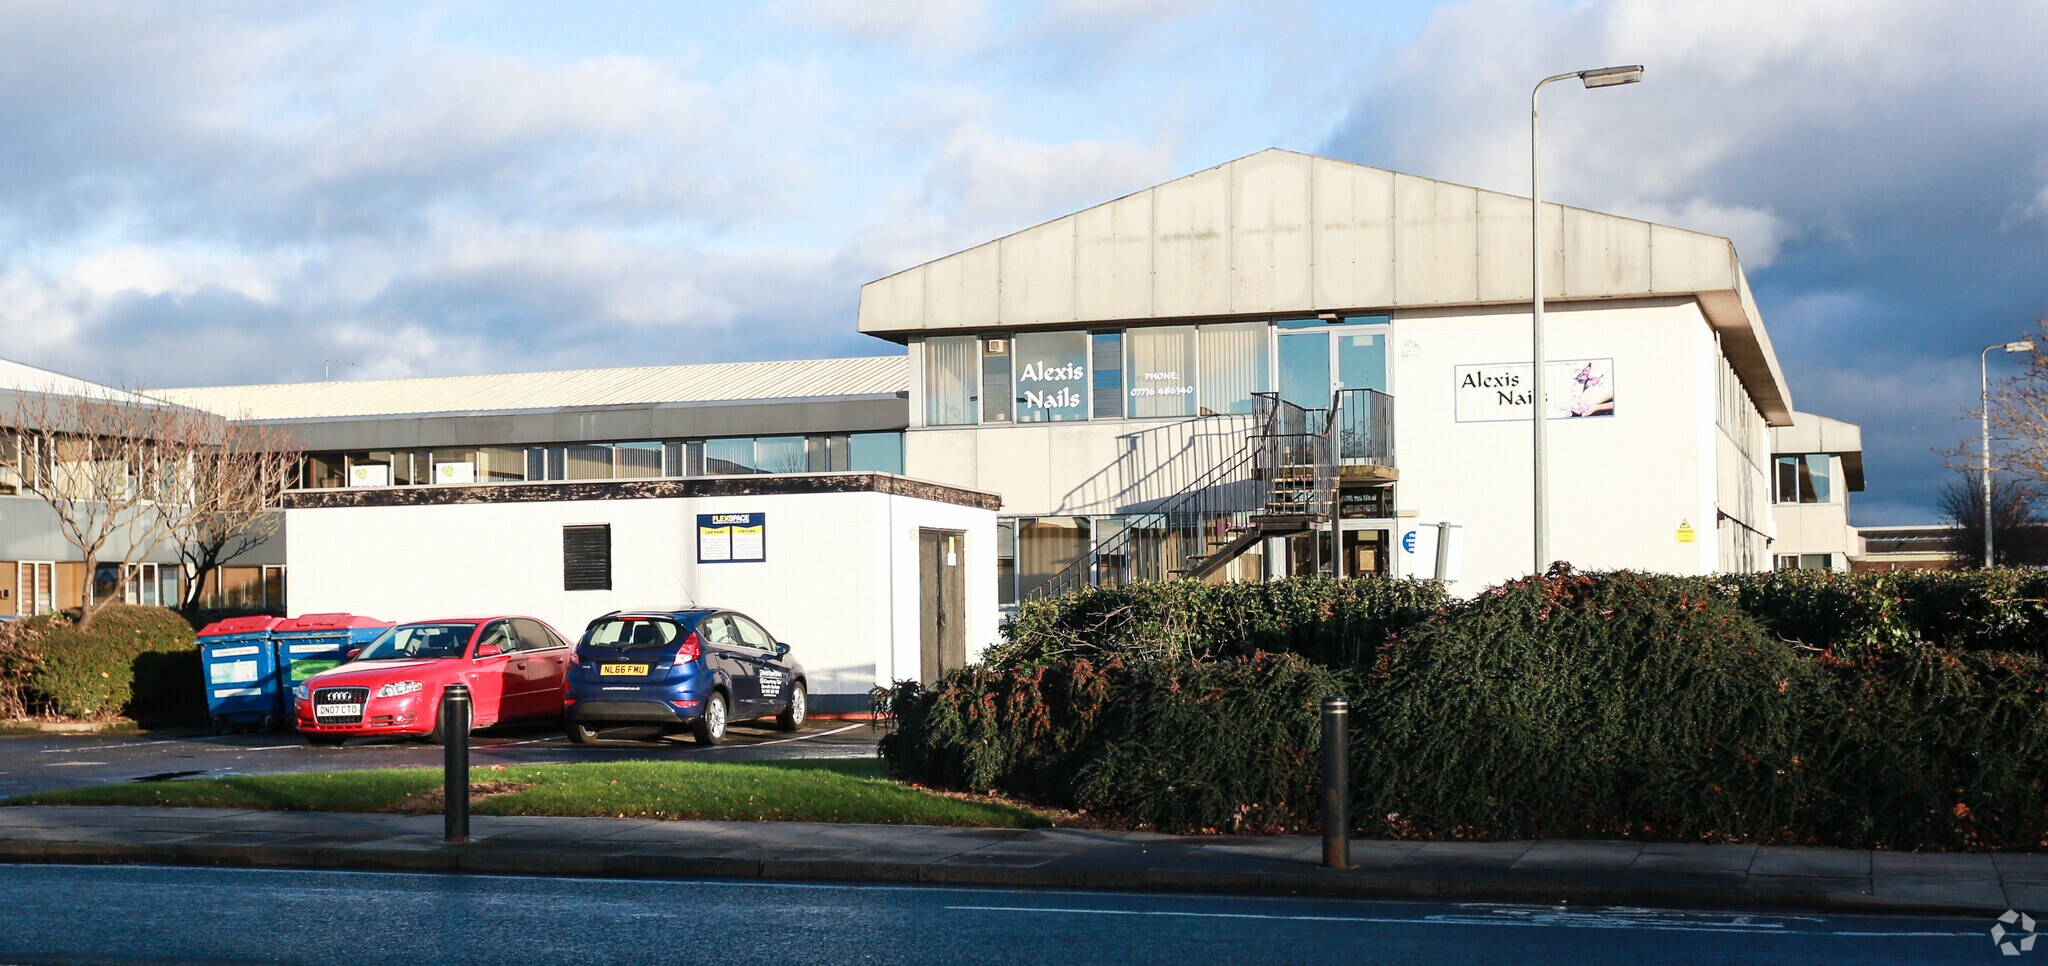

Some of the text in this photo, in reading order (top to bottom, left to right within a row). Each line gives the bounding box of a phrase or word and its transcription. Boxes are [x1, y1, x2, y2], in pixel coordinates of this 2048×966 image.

[1020, 360, 1084, 382] Alexis
[1144, 371, 1179, 381] PHONE:
[1461, 371, 1519, 388] Alexis
[1130, 385, 1194, 396] 07716 486340
[1024, 386, 1081, 409] Nails
[1496, 390, 1548, 406] Nai
[604, 665, 645, 674] NL66 FMU
[320, 705, 357, 715] DN07 CTO
